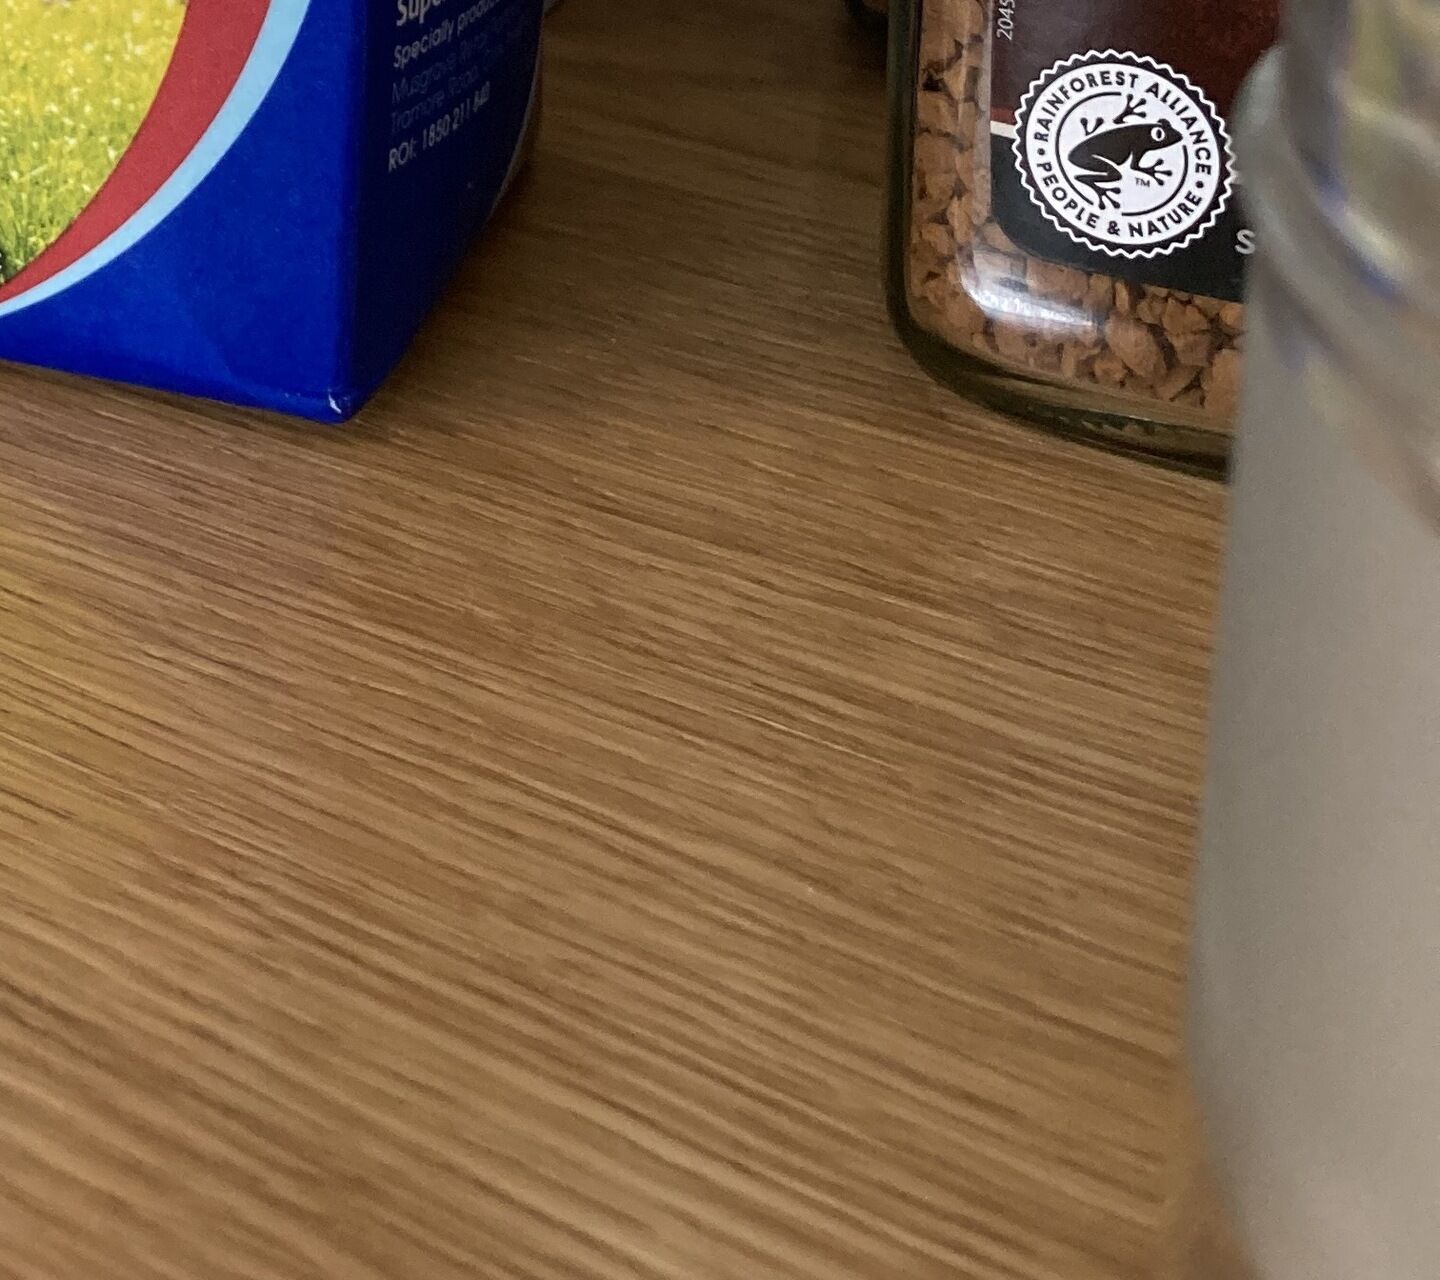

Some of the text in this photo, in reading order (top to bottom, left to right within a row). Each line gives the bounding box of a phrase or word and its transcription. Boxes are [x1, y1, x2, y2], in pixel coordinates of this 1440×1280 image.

[393, 18, 455, 70] Specially
[1035, 70, 1139, 143] RAINFOREST
[1146, 82, 1211, 176] ALLIANCE
[1036, 161, 1098, 230] PEOPLE
[1128, 190, 1203, 239] NATURE
[1107, 220, 1121, 237] &
[1234, 228, 1257, 255] S
